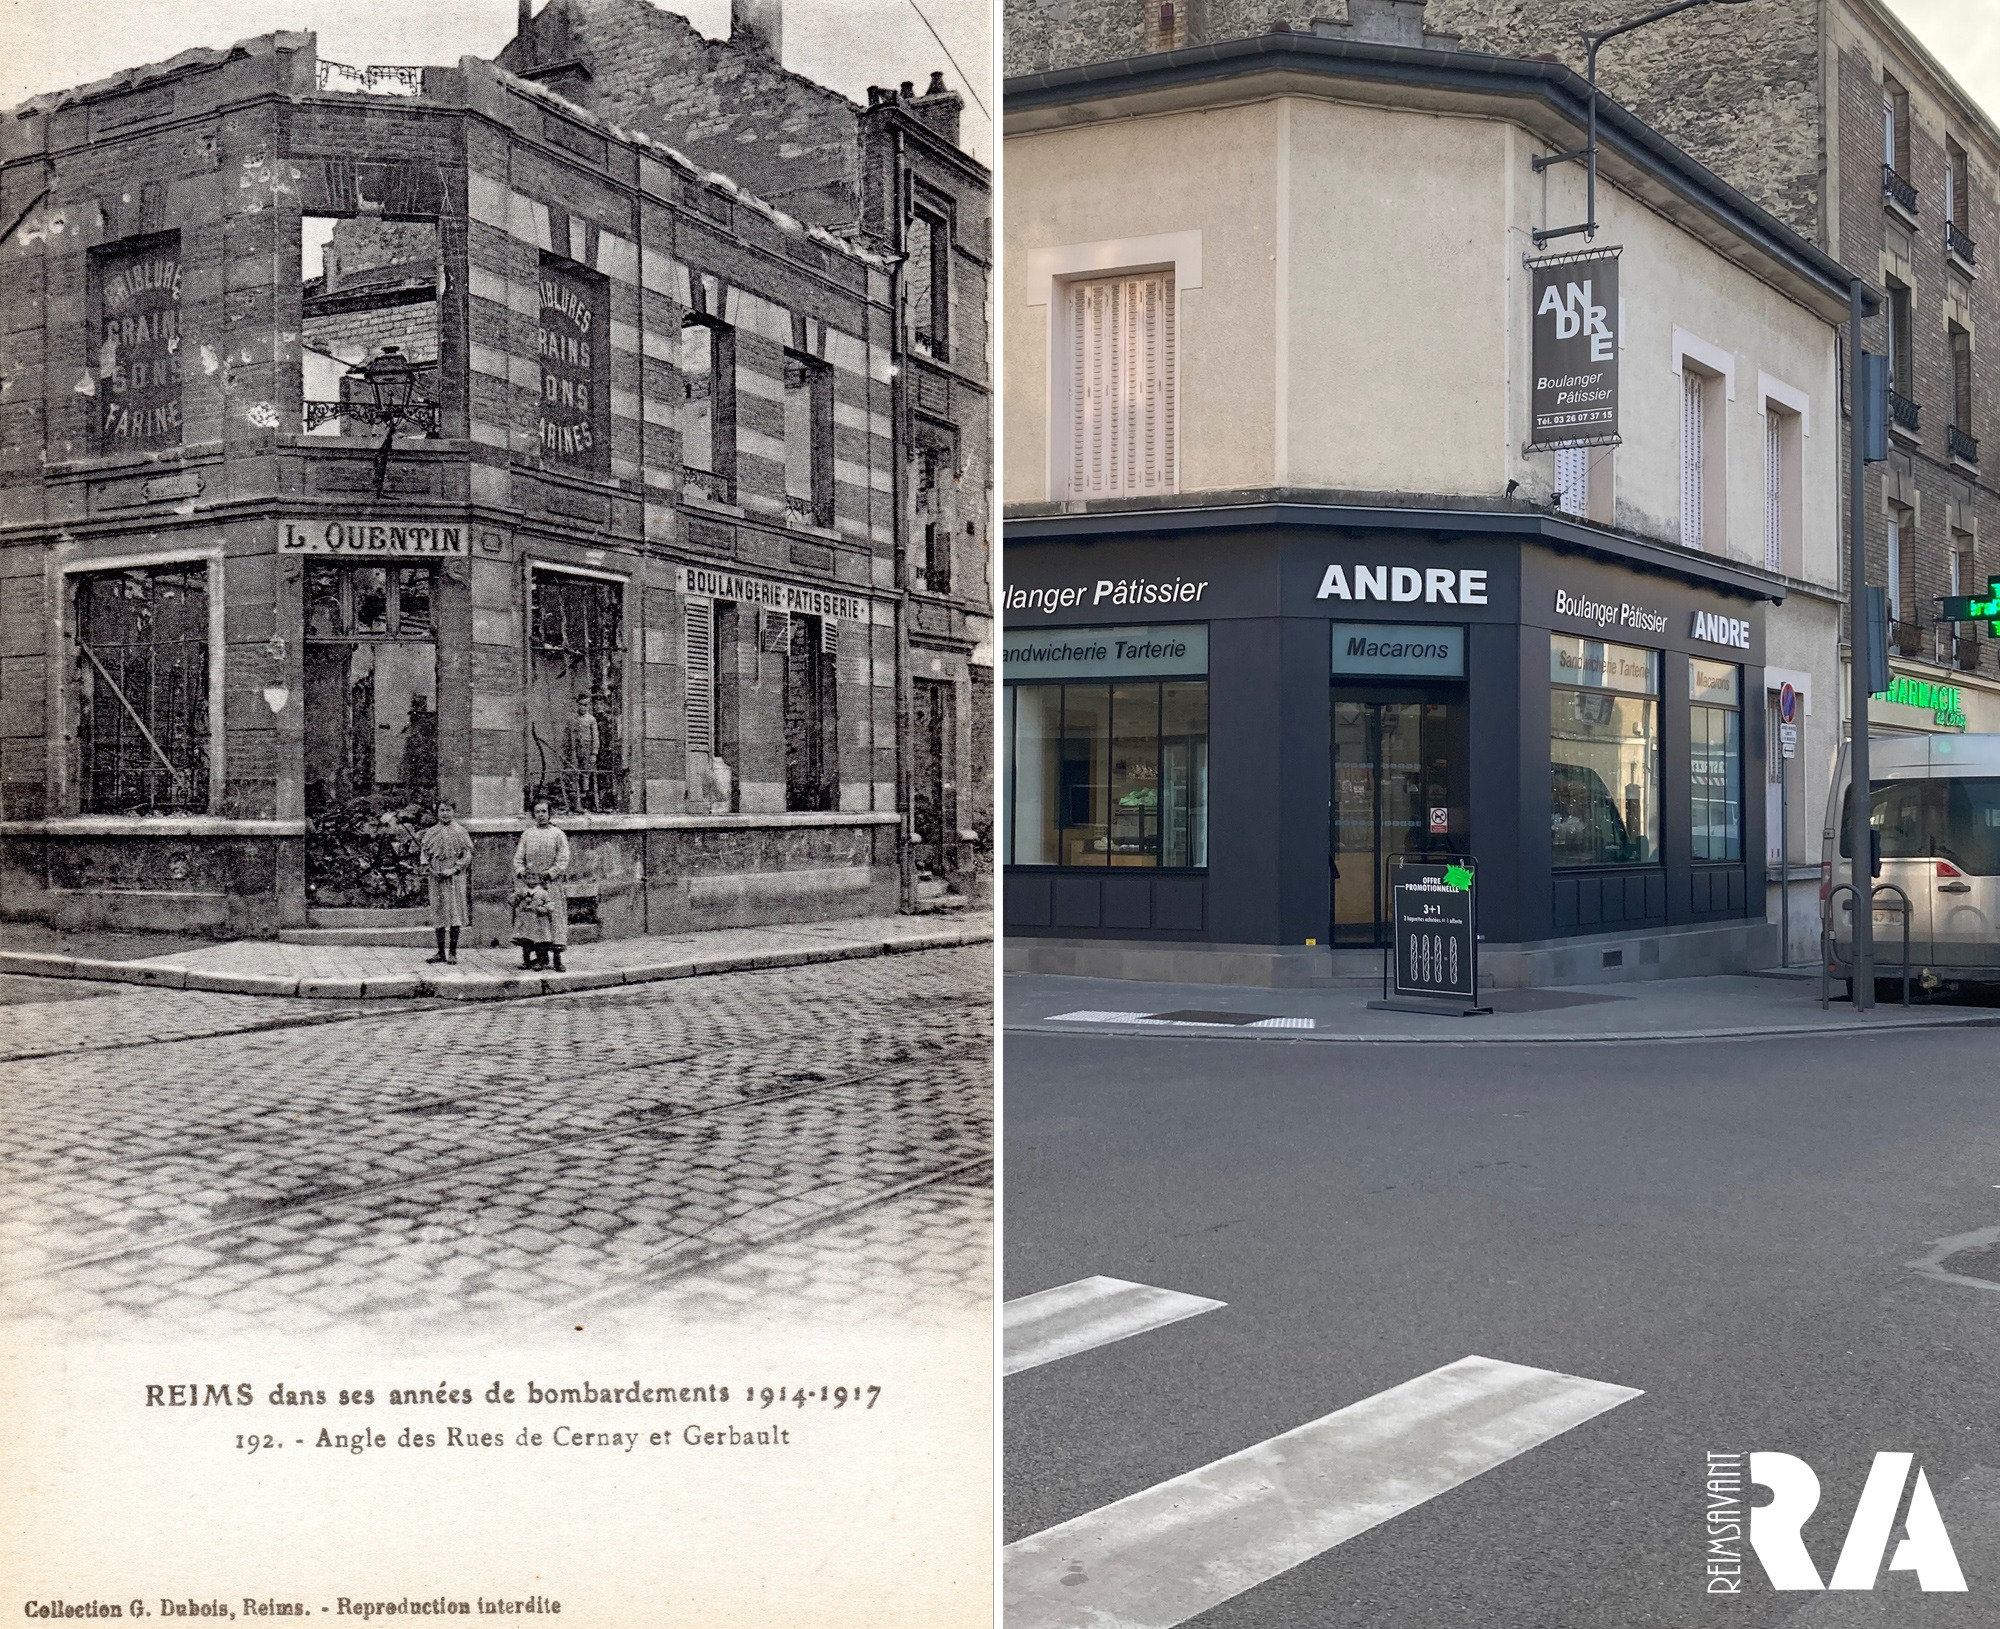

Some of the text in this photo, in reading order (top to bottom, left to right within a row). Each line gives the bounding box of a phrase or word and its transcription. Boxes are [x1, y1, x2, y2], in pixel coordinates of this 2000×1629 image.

[1537, 372, 1603, 390] Boulanger
[1557, 388, 1613, 405] Pâtissier
[1537, 410, 1613, 426] Tél. 03 26 07 37 15
[284, 522, 461, 553] L. QUENTIN
[1093, 577, 1208, 606] Pâtissier
[1316, 564, 1488, 605] ANDRE
[1555, 589, 1668, 633] Boulanger Pâtissier
[1692, 610, 1750, 649] ANDRE
[1114, 639, 1187, 660] Tarterie
[1347, 637, 1449, 659] Macarons
[1560, 649, 1650, 679] Sandwicherie Tarterie
[1696, 671, 1730, 691] Macarons
[1876, 677, 1961, 713] HARMACIE
[1405, 883, 1459, 893] PROMOTIONNELLE
[1423, 904, 1441, 915] 3+1
